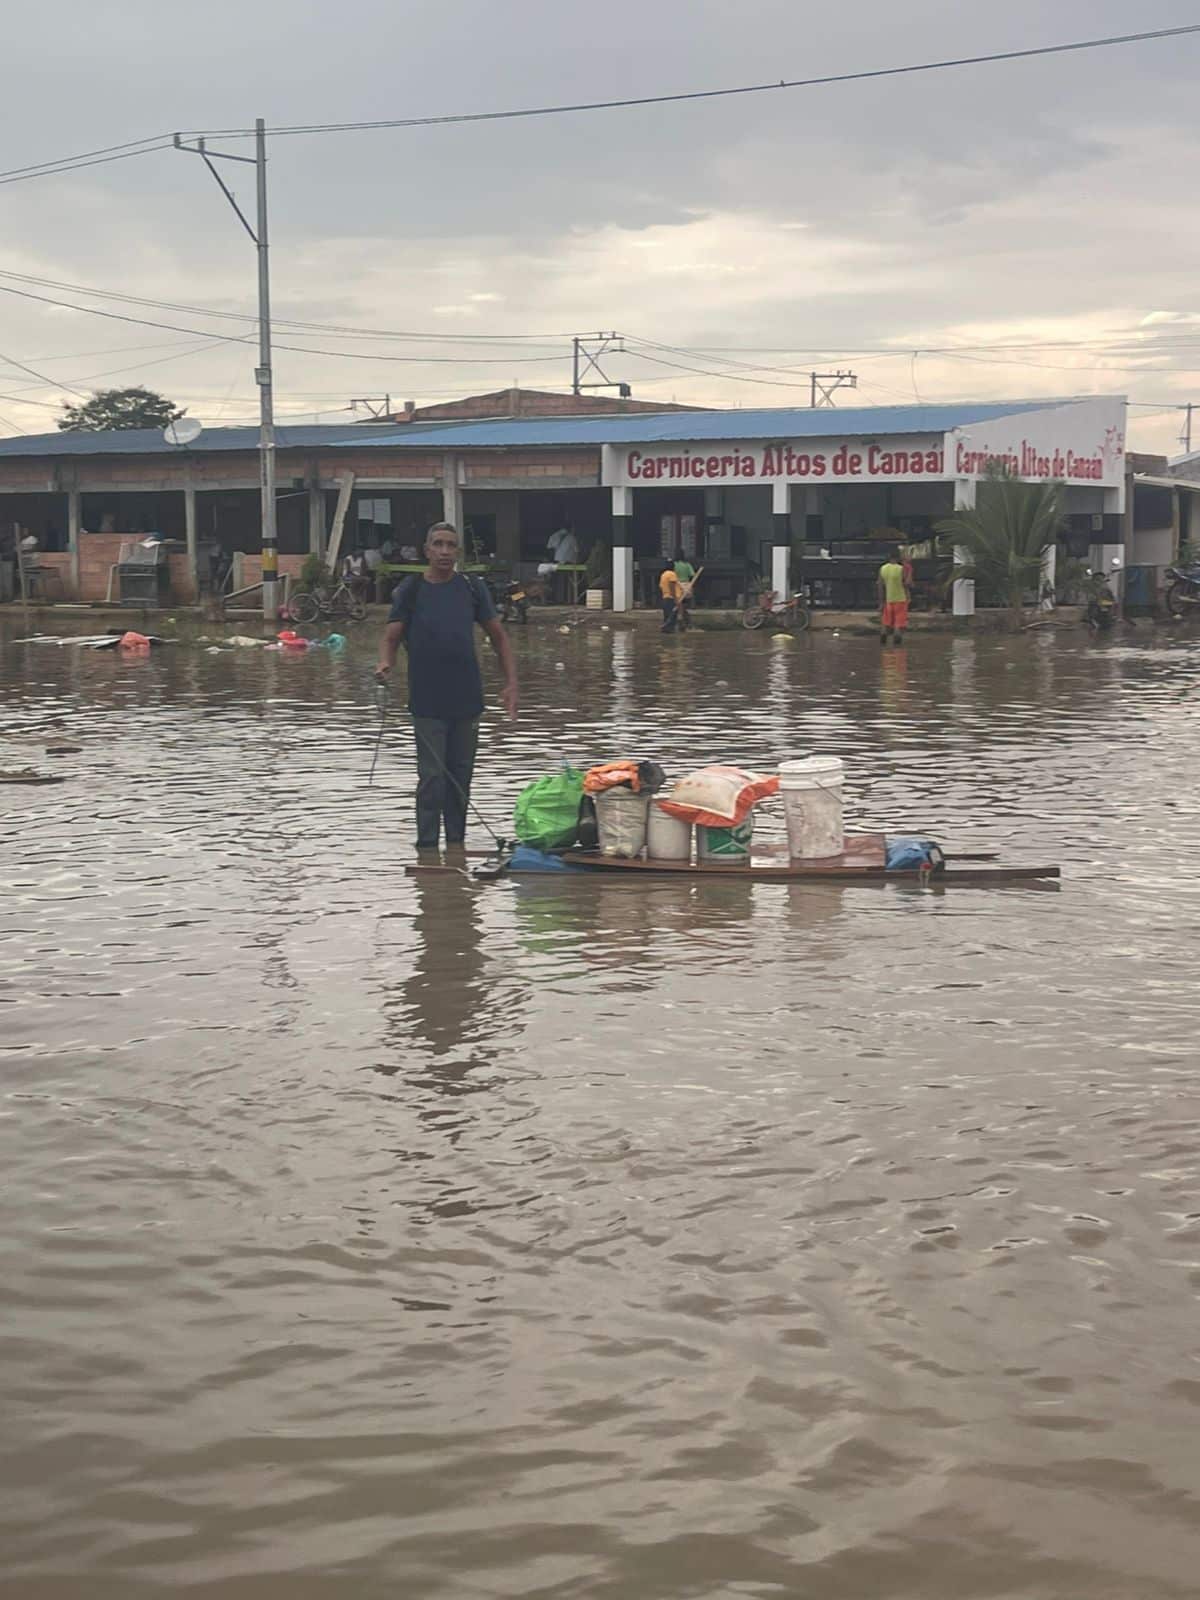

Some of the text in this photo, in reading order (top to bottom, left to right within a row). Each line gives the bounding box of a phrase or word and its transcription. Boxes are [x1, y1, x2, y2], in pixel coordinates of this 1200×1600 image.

[627, 448, 756, 479] Carniceria
[760, 446, 826, 477] Altos
[832, 444, 862, 475] de
[1021, 439, 1050, 477] Altos
[1052, 448, 1065, 478] de
